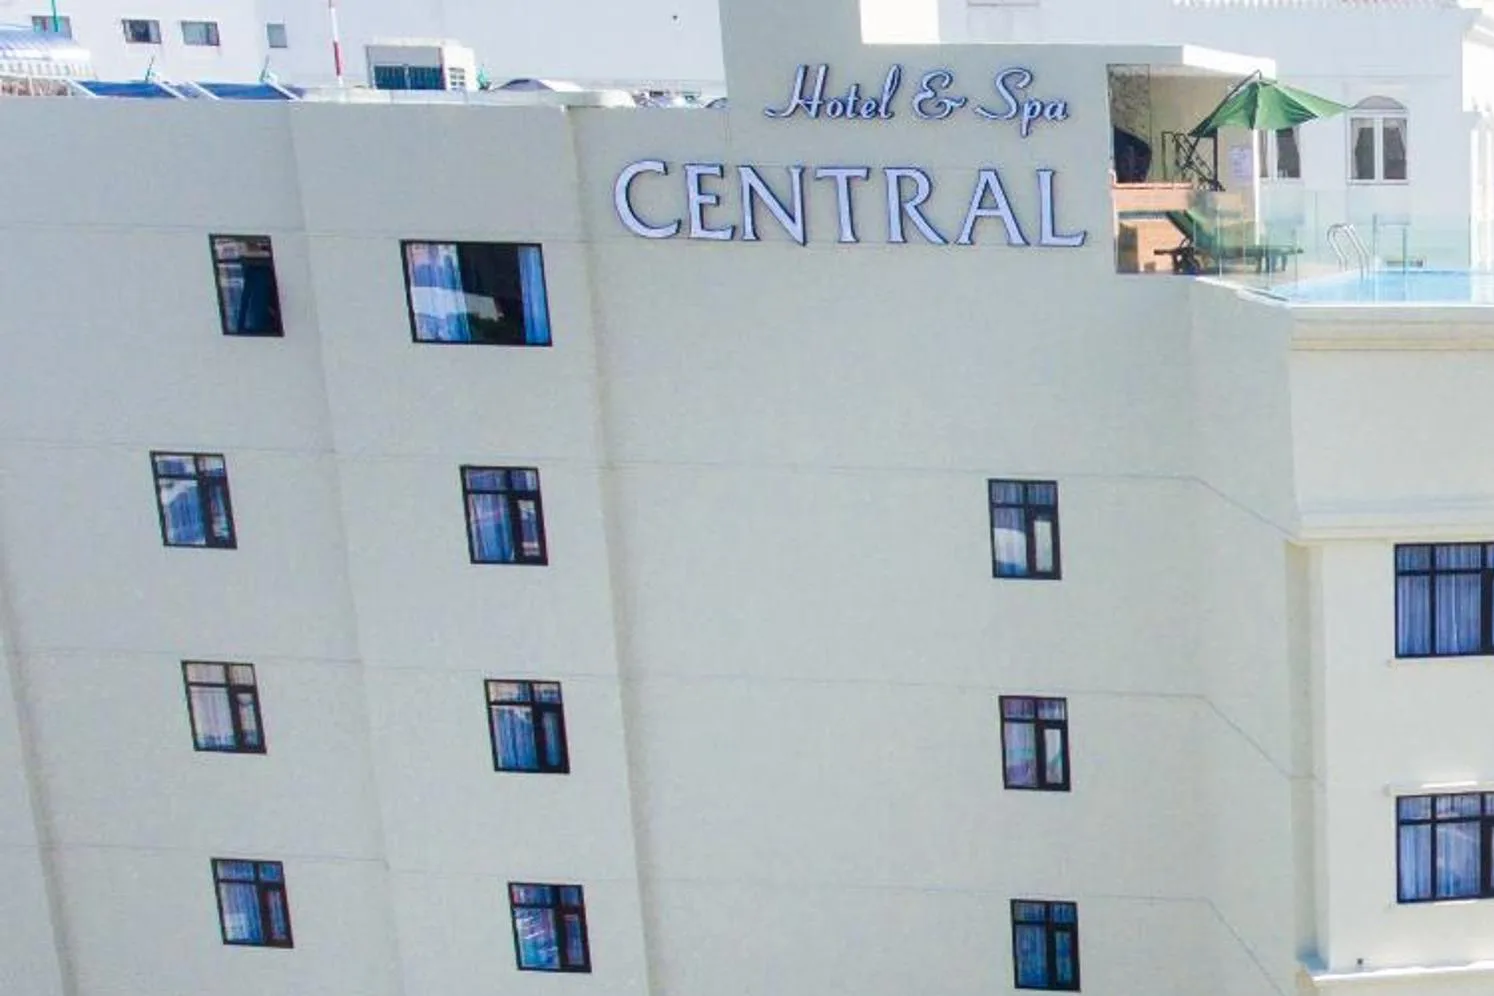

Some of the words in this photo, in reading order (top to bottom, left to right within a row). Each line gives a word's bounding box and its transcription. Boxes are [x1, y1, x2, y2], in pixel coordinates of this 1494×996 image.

[765, 63, 902, 120] Hotel
[914, 69, 967, 120] &
[975, 67, 1070, 138] Spa
[613, 160, 1088, 246] CENTRAL
